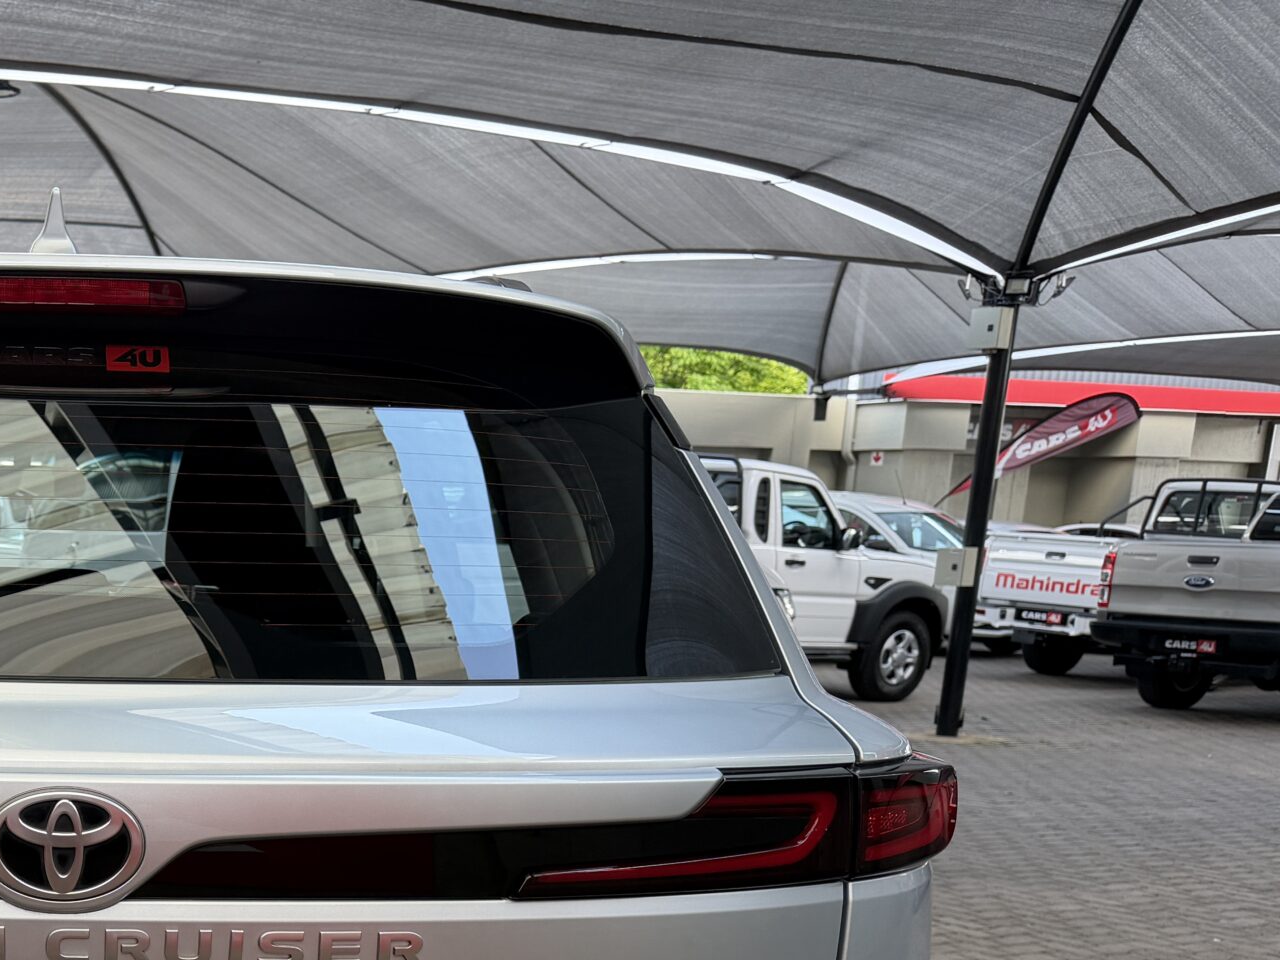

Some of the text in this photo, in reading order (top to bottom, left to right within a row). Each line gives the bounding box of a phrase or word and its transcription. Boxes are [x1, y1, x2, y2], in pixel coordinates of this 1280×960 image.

[112, 348, 163, 368] 4U
[1021, 610, 1047, 621] CARS
[1165, 639, 1197, 650] CARS
